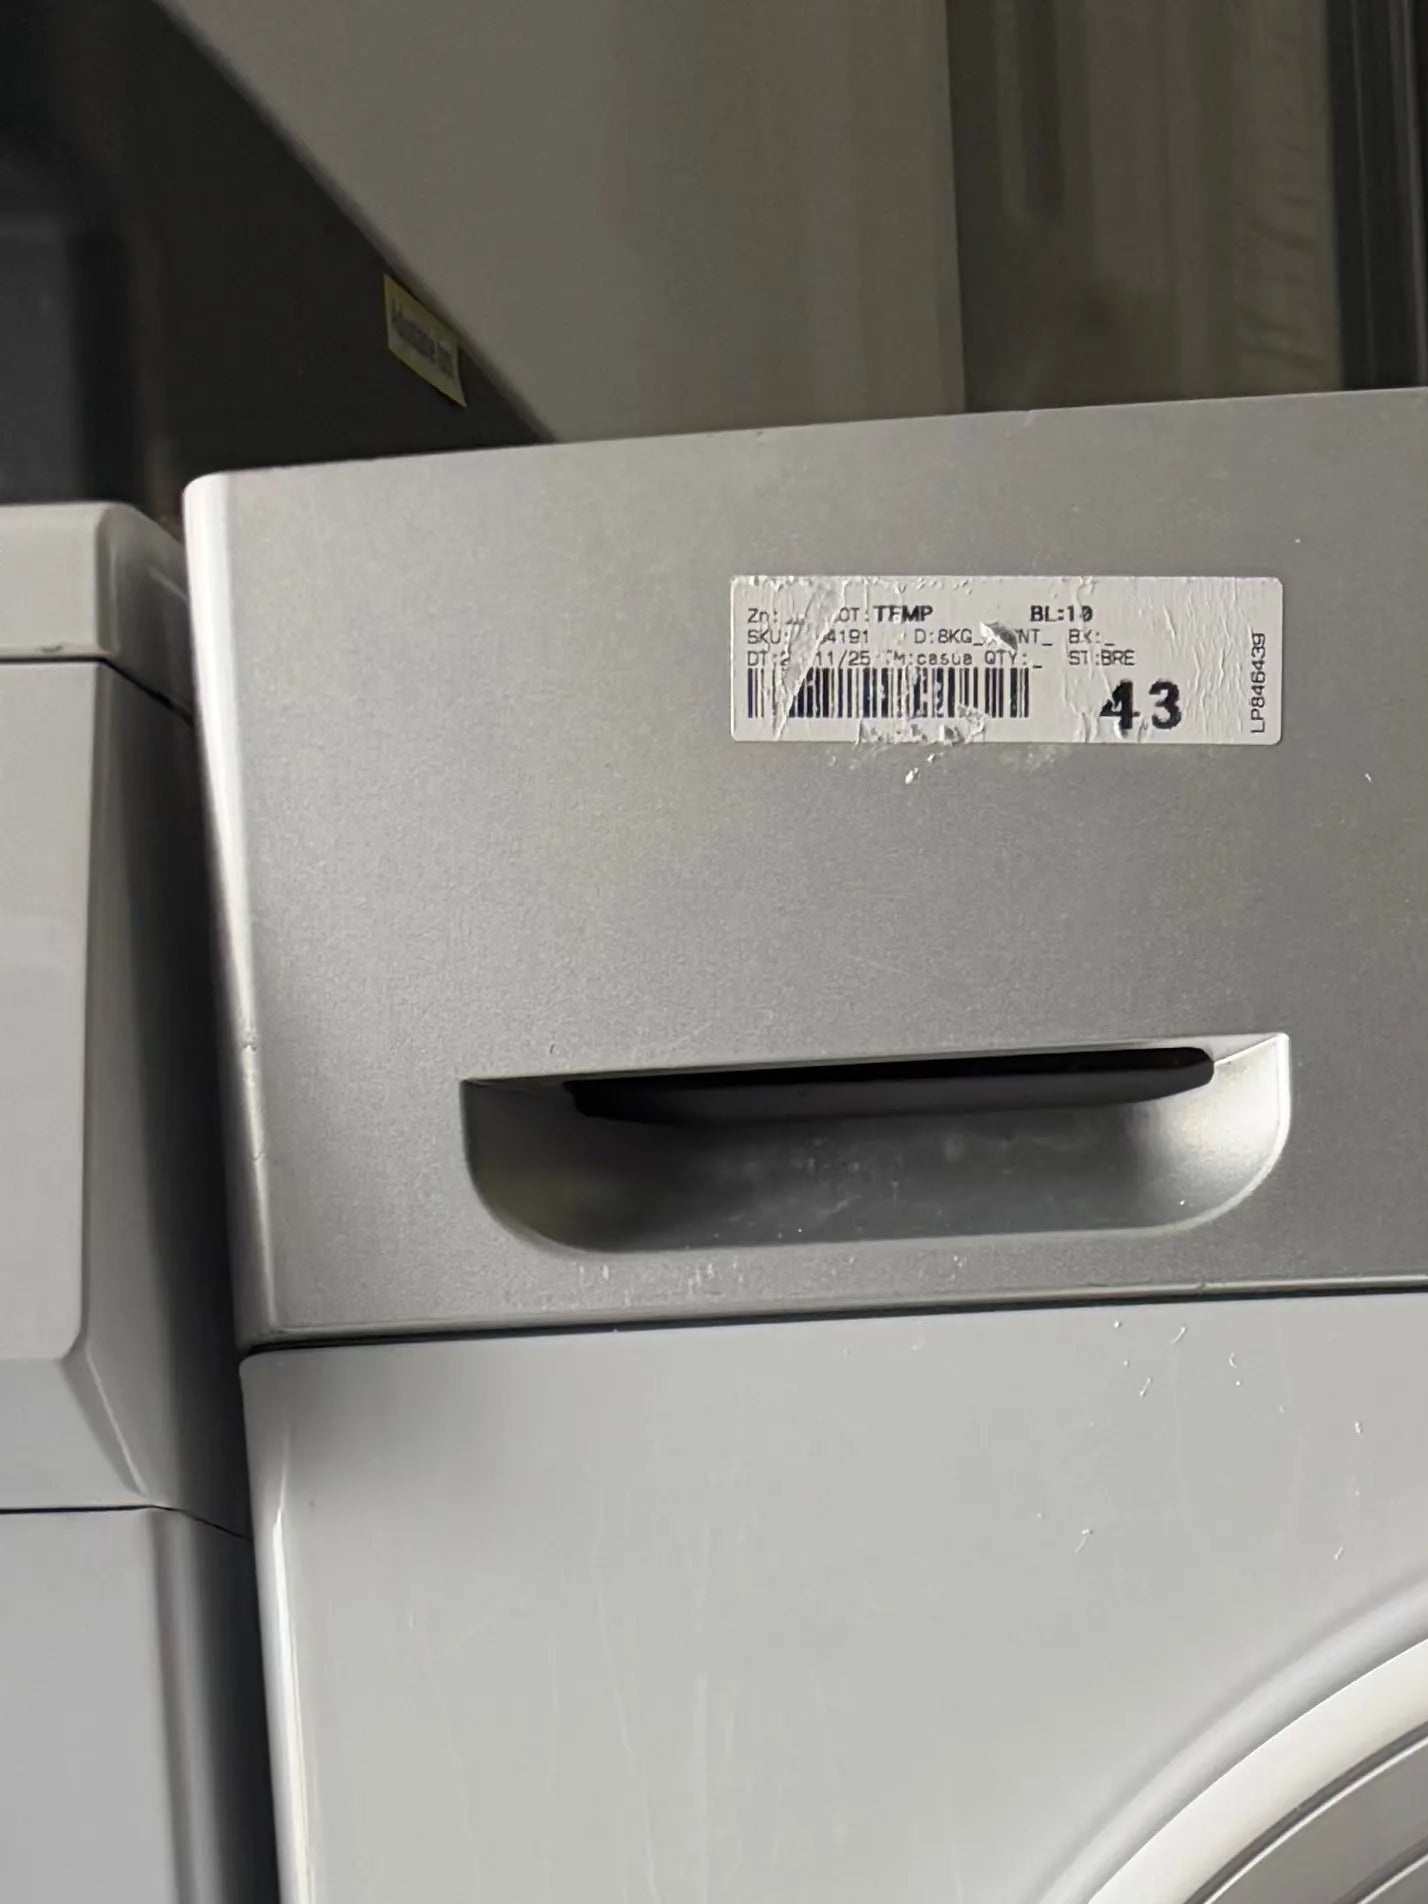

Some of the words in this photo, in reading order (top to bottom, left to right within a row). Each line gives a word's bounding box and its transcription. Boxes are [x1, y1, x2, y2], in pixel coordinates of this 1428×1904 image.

[1068, 649, 1135, 666] ST:BRE
[1250, 631, 1265, 733] LP846439
[1100, 678, 1182, 730] 43
